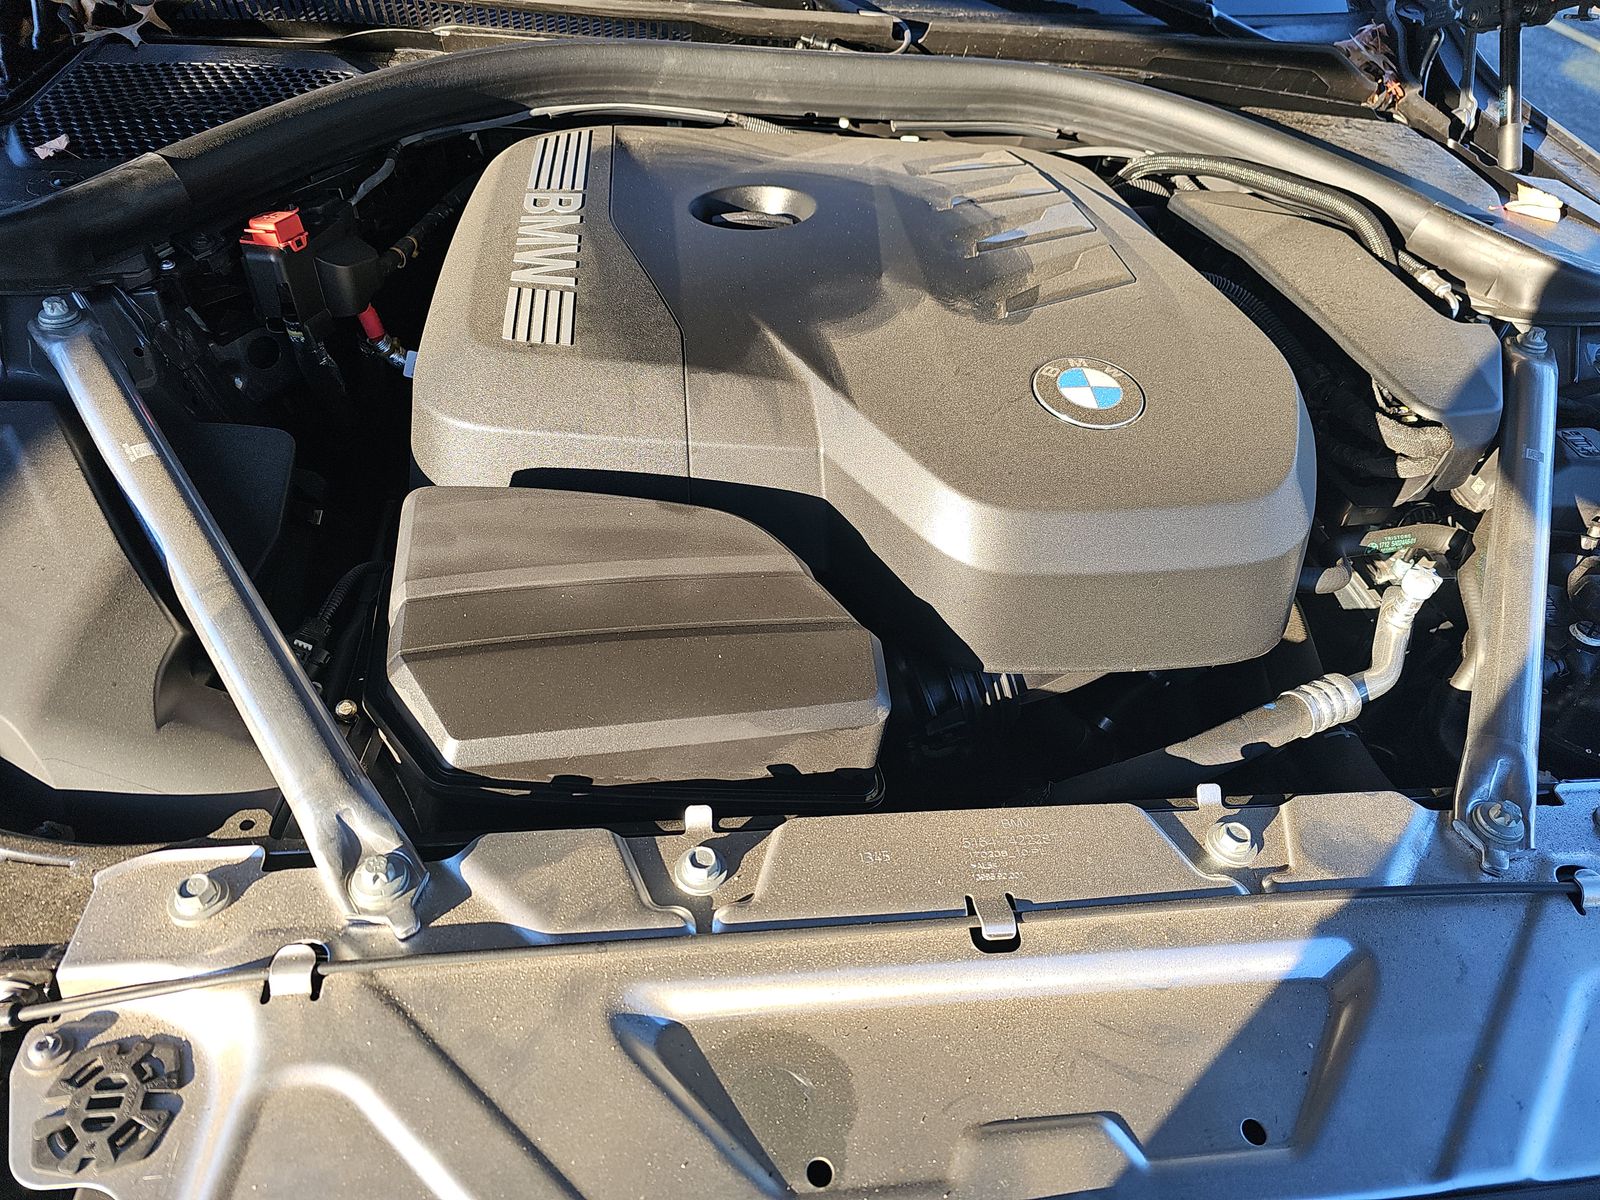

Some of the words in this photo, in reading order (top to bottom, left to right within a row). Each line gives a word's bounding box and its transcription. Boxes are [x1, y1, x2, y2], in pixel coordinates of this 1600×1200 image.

[511, 193, 585, 287] BMW
[1041, 358, 1124, 378] BMW
[1002, 818, 1035, 829] BMW
